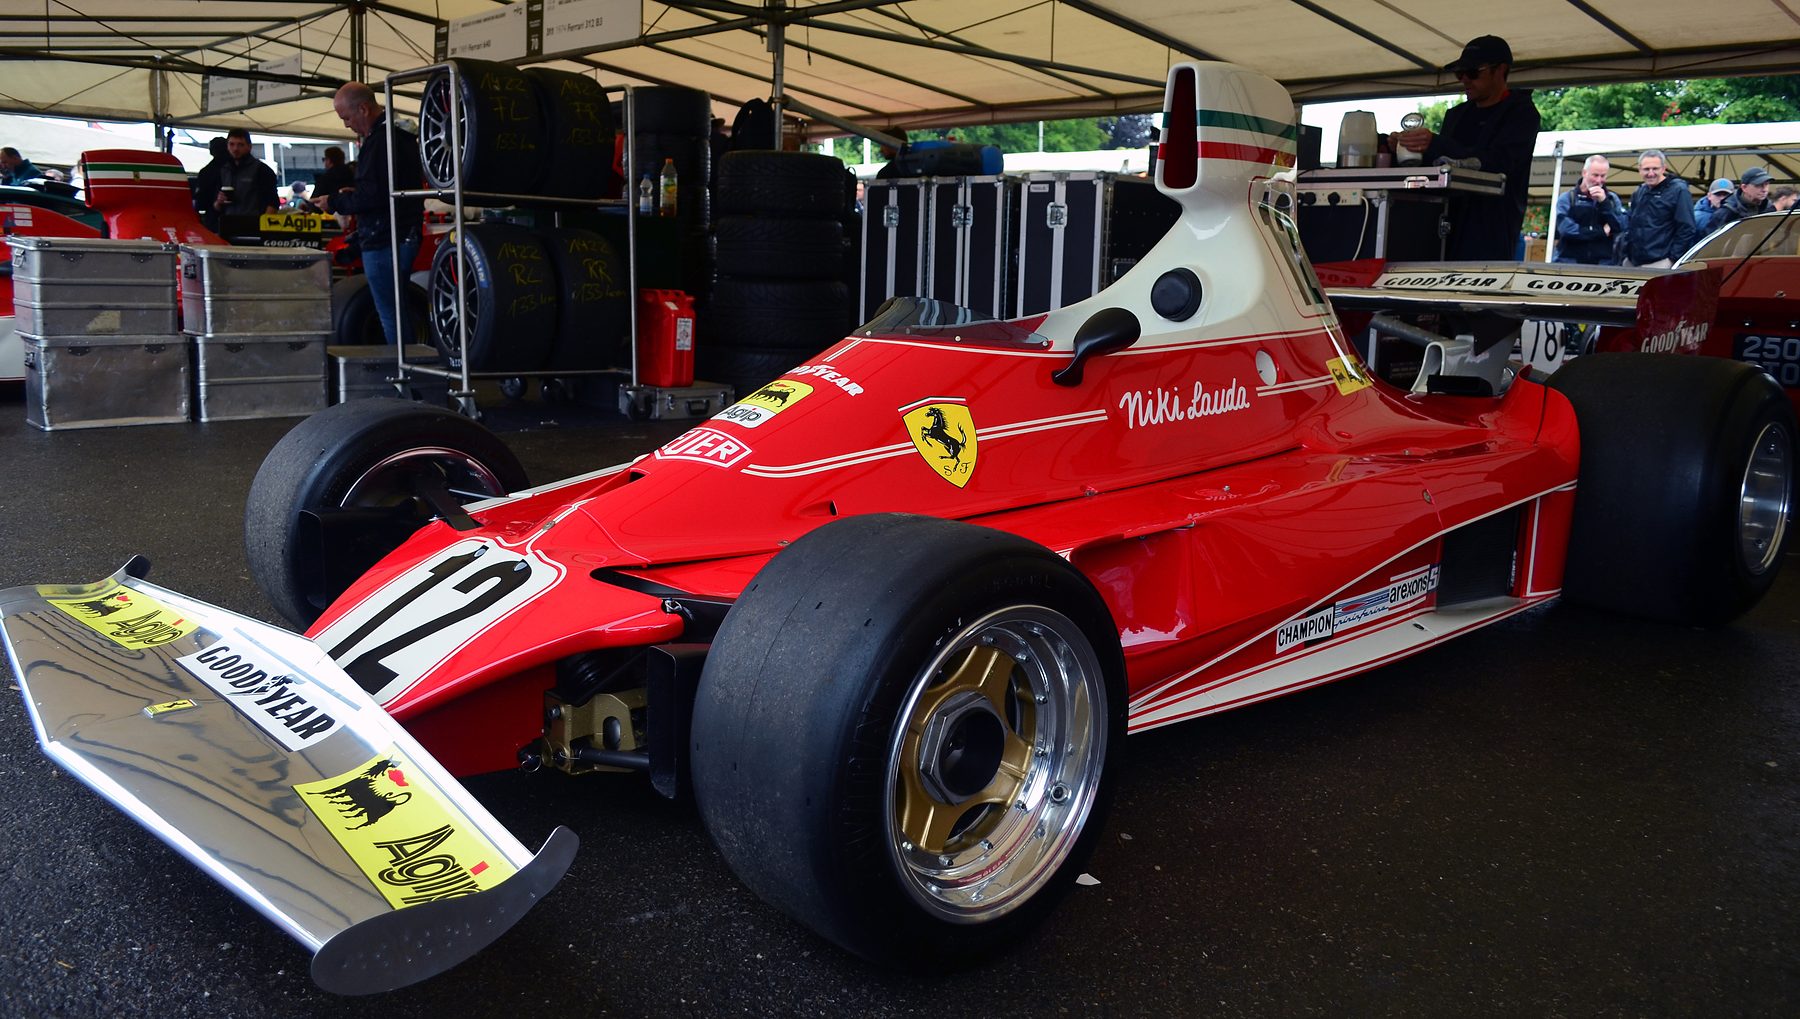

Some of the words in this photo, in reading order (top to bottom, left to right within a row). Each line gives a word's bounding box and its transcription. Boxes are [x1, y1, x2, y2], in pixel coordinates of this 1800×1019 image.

[585, 18, 595, 29] 312
[284, 215, 317, 232] Agip
[264, 239, 320, 249] GOODYEAR
[508, 263, 543, 286] RL
[582, 257, 614, 285] RR
[1384, 274, 1497, 287] GOODYEAR
[1530, 320, 1558, 361] 78
[1641, 318, 1709, 353] GOODYEAR
[1743, 335, 1800, 361] 250
[1119, 386, 1185, 429] Niki
[1187, 378, 1251, 419] Lauda
[944, 465, 953, 476] S
[1390, 574, 1429, 604] arexons
[107, 609, 184, 644] Agip
[327, 545, 532, 695] 12
[1278, 612, 1333, 647] CHAMPION
[196, 646, 335, 740] GOODYEAR
